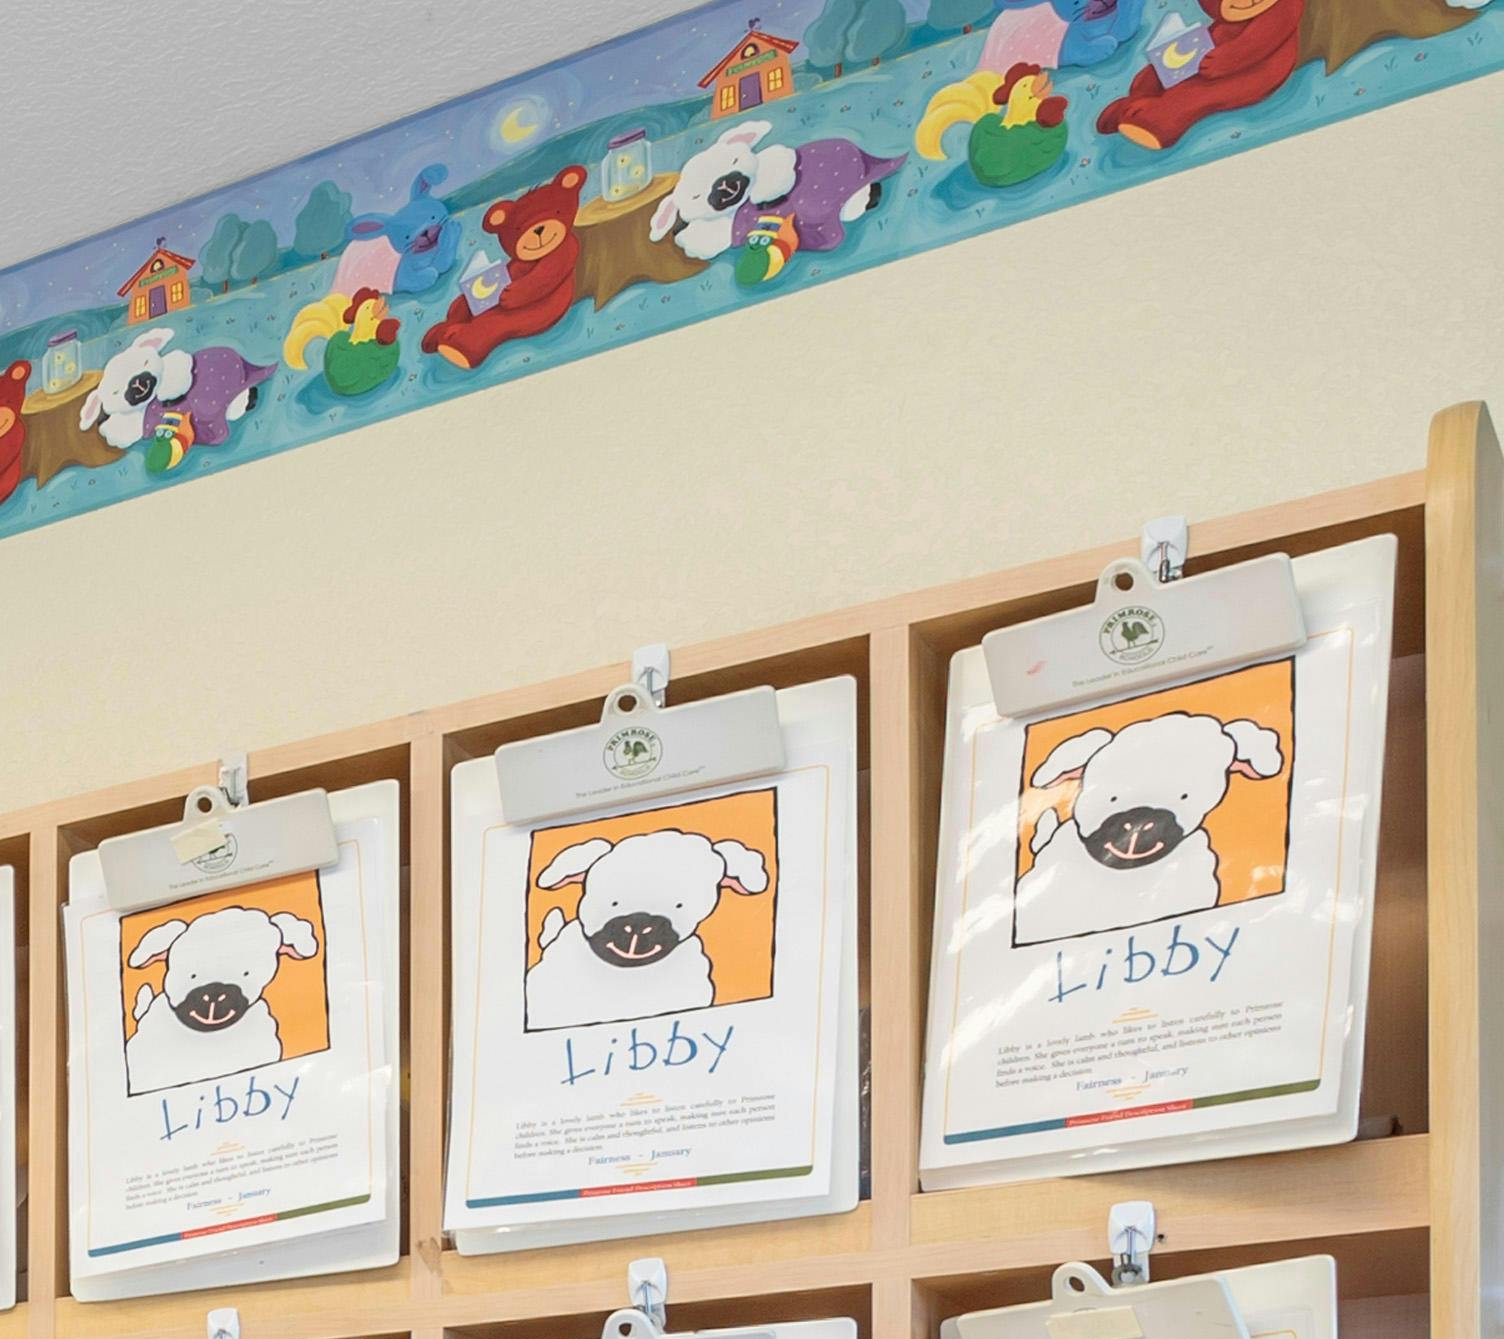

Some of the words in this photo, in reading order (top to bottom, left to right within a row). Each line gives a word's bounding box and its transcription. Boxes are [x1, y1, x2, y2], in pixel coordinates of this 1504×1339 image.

[608, 729, 655, 751] PRIMROSE
[1049, 924, 1240, 1005] Libby
[562, 1023, 735, 1087] Libby
[159, 1076, 301, 1141] Libby
[588, 1153, 632, 1166] Fairness
[650, 1147, 692, 1160] January
